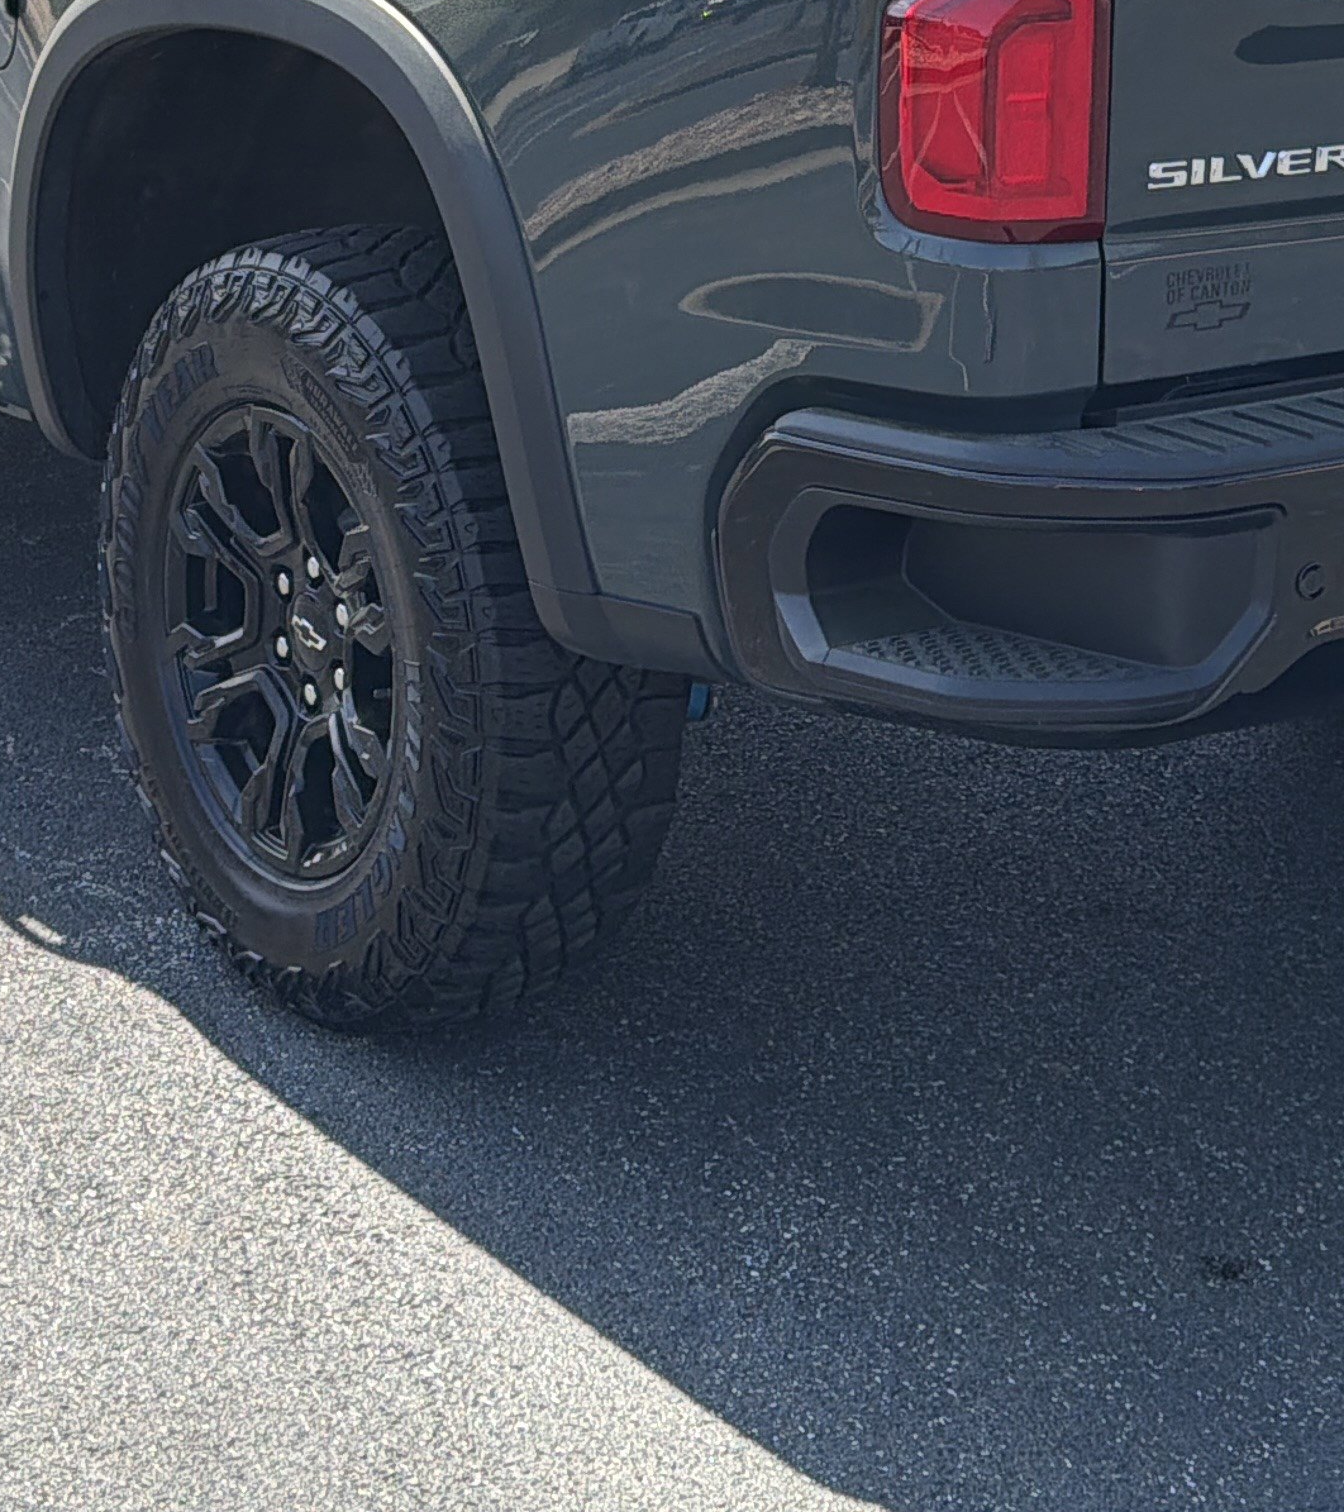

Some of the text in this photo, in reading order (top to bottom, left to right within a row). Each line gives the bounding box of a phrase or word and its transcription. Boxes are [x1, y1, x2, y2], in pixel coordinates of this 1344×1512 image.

[1167, 262, 1251, 287] CHEVROLET
[1167, 279, 1251, 305] OF CANTON
